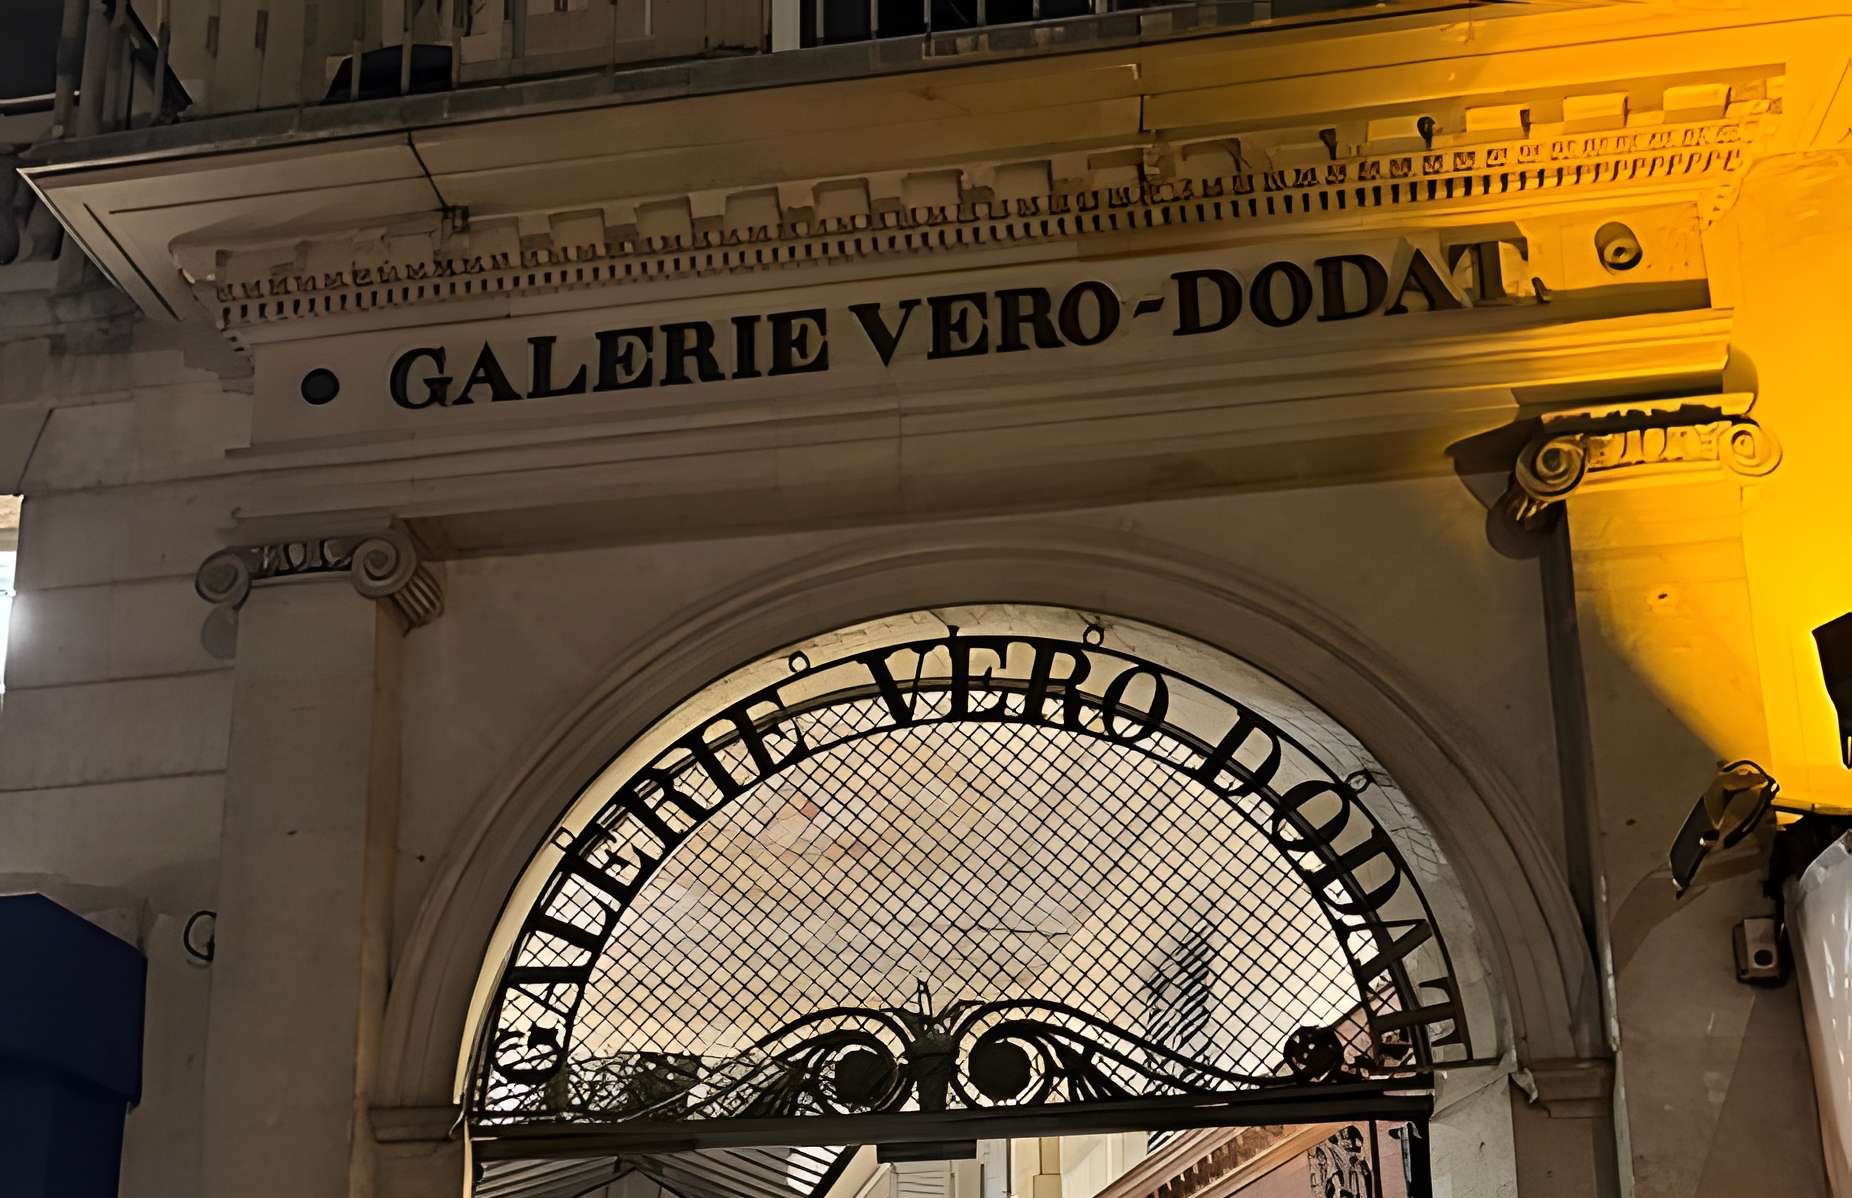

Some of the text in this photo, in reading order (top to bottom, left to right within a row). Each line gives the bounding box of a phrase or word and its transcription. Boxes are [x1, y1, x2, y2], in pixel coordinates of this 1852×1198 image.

[388, 232, 1532, 410] GALERIE VERO-DODAT
[490, 634, 1472, 1082] GALERIE VERO DODAT
